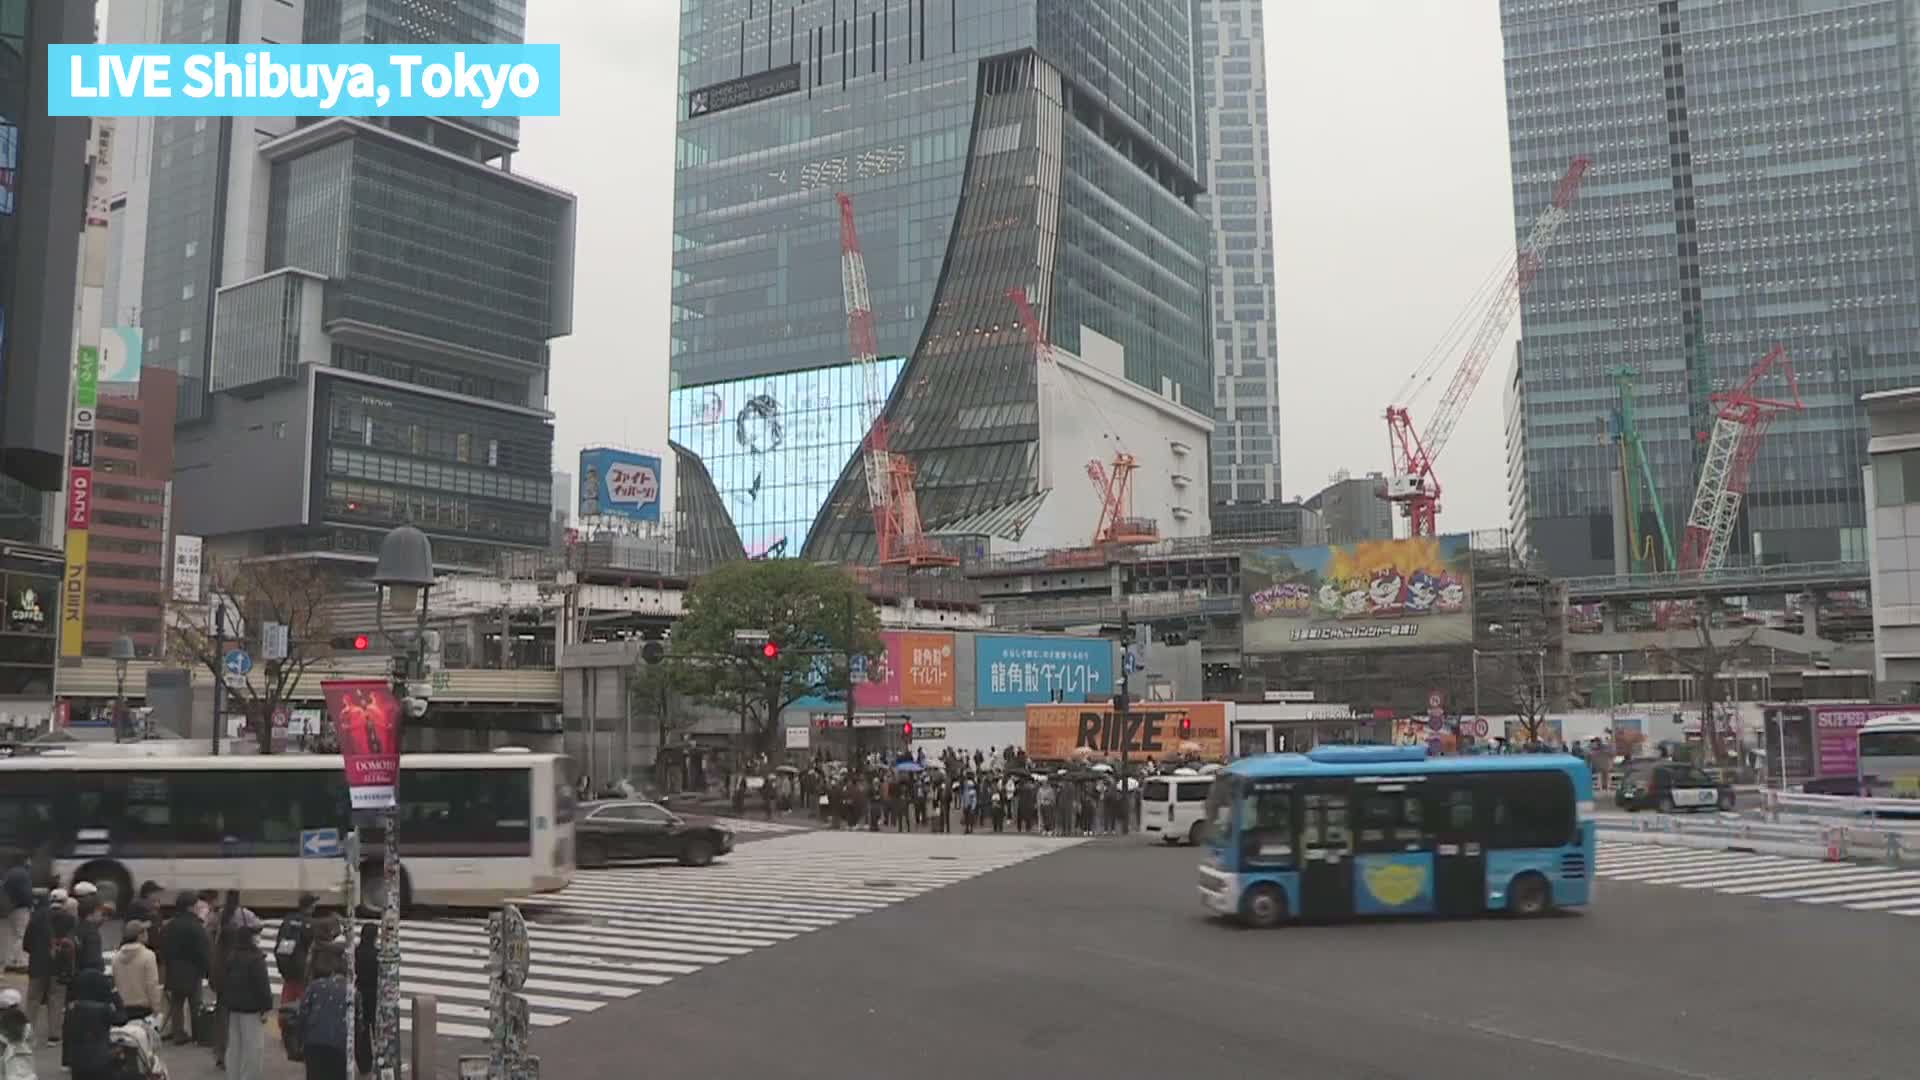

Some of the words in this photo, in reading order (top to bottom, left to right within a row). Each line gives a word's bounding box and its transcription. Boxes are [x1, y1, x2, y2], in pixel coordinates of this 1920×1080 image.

[613, 469, 651, 484] ファイト
[66, 565, 84, 621] プロミス
[991, 662, 1100, 693] 龍角散ダイレクト
[1076, 711, 1166, 751] RIIZE
